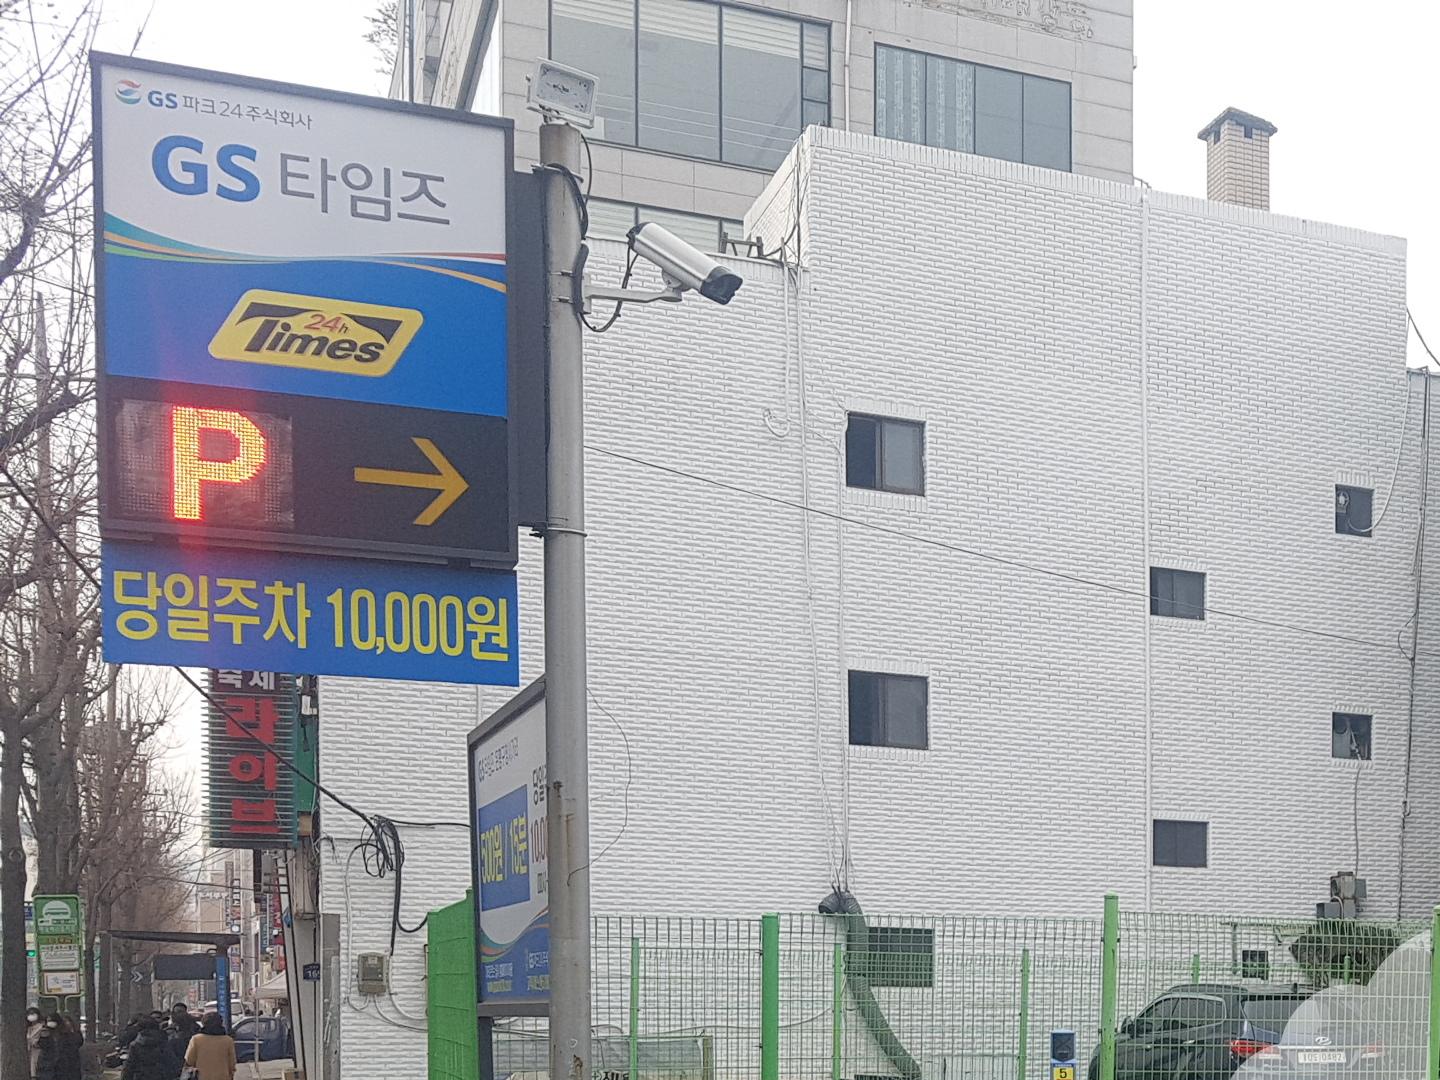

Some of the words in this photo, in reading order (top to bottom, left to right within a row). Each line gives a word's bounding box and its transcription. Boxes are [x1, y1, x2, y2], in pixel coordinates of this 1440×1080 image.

[147, 90, 178, 110] GS
[182, 94, 313, 131] 파크24주식회사
[151, 135, 261, 203] GS
[279, 151, 451, 226] 타임즈
[244, 318, 385, 364] Times
[304, 313, 349, 335] 24h
[172, 405, 267, 521] P
[113, 570, 312, 650] 당일주차
[327, 586, 509, 663] 10,000원
[225, 697, 281, 834] 라이브
[1059, 1068, 1067, 1079] 5
